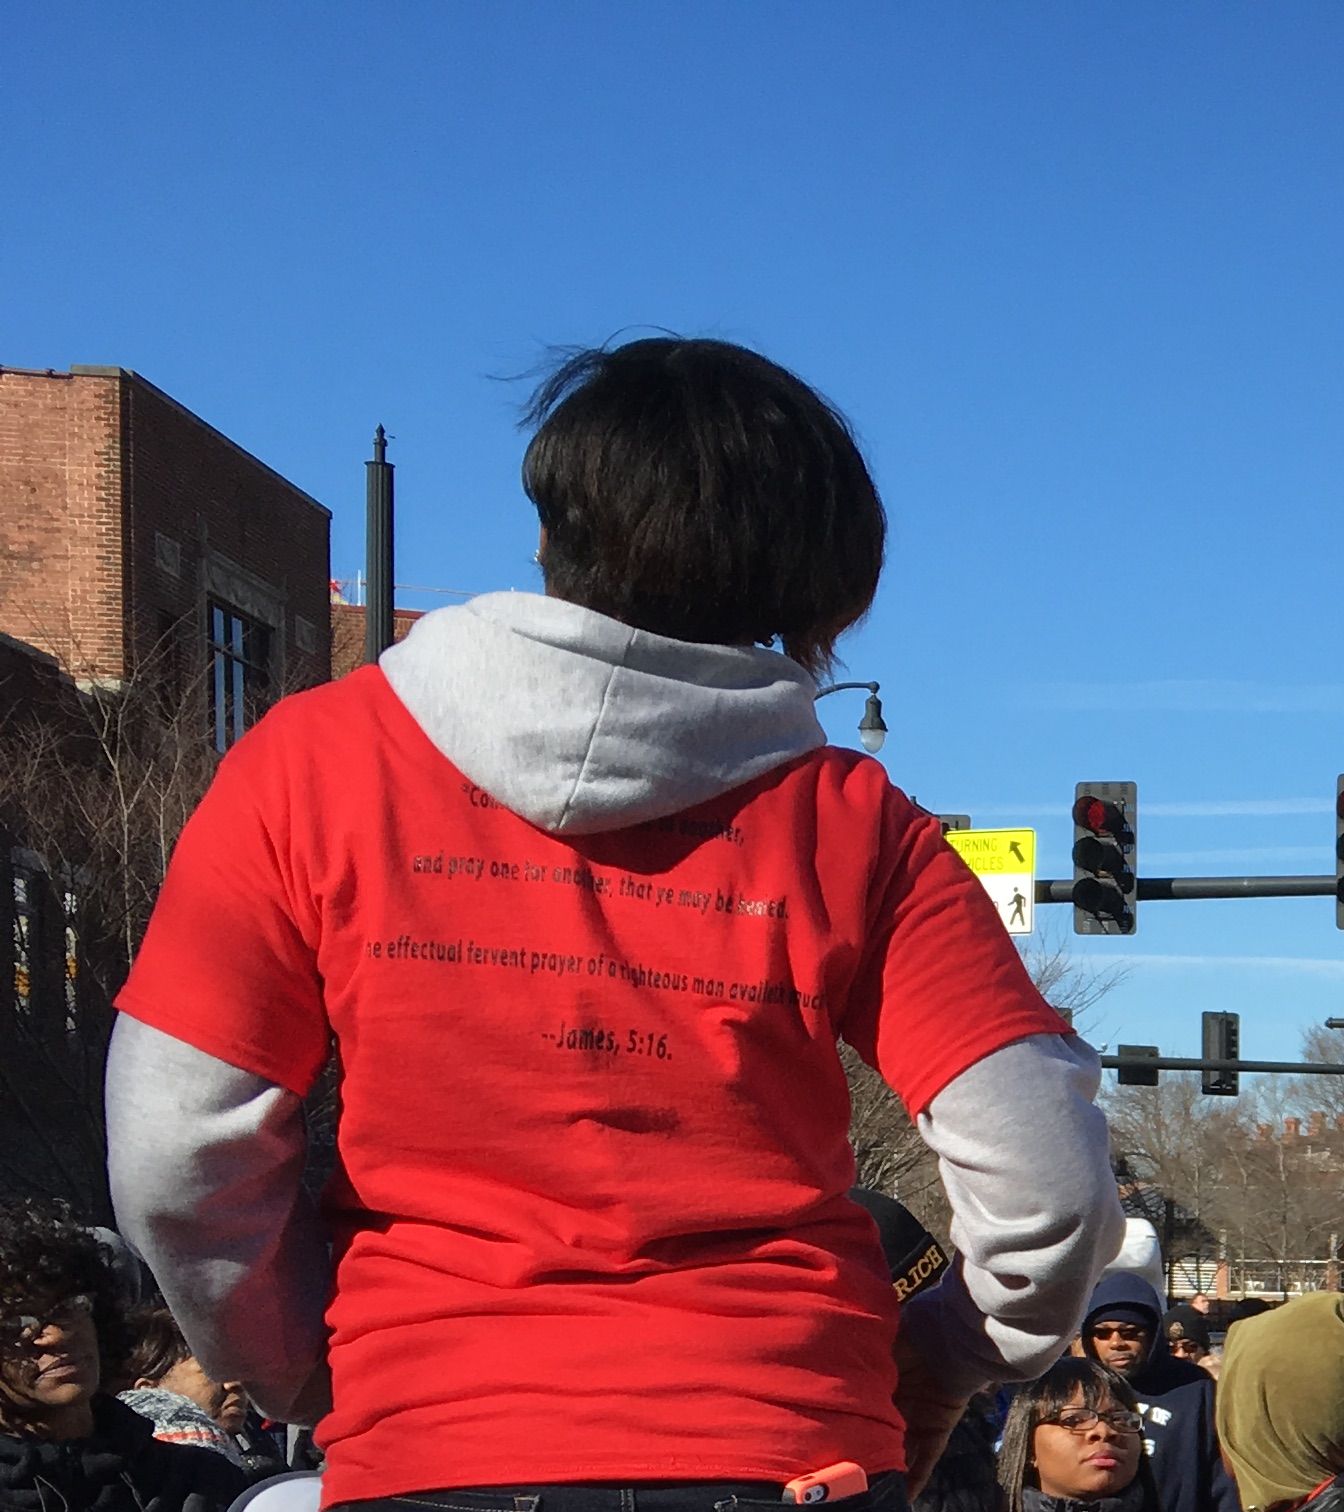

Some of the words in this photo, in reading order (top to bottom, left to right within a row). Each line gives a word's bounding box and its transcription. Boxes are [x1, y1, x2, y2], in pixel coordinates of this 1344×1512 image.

[413, 850, 443, 874] and
[448, 856, 485, 880] pray
[490, 861, 519, 880] one
[524, 859, 547, 882] for
[619, 875, 652, 898] that
[656, 886, 674, 908] ye
[678, 891, 711, 915] may
[715, 887, 733, 914] be
[967, 857, 1004, 871] HICLES
[387, 935, 462, 964] effectual
[467, 940, 527, 968] fervent
[530, 950, 583, 978] prayer
[587, 953, 604, 977] of
[608, 962, 616, 978] a
[620, 958, 689, 992] righteous
[692, 976, 725, 999] man
[626, 1029, 673, 1061] 5:16.
[892, 1244, 944, 1301] RICH
